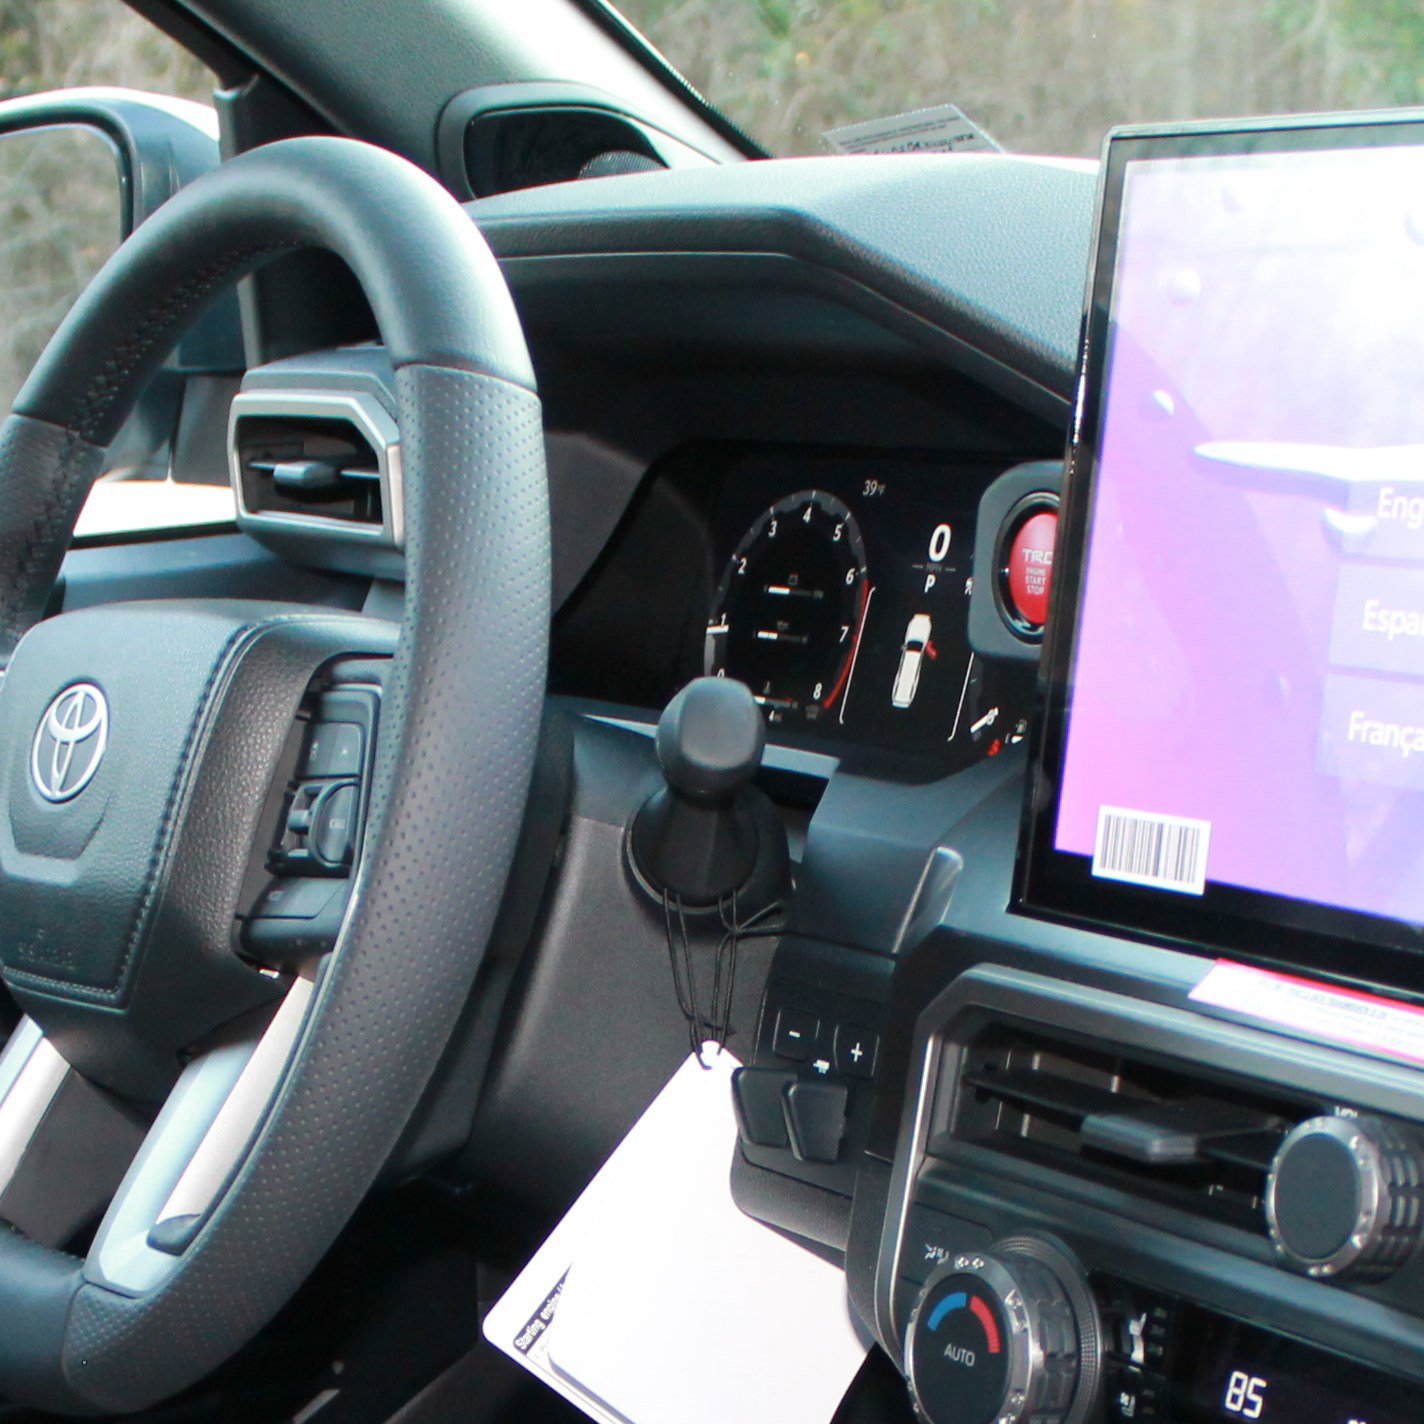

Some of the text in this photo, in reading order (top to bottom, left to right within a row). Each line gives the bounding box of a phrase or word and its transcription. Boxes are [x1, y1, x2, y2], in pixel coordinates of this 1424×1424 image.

[802, 506, 812, 523] 4
[768, 520, 778, 537] 3
[832, 524, 843, 541] 5
[928, 523, 952, 563] 0
[737, 557, 748, 575] 2
[845, 567, 855, 585] 6
[924, 573, 936, 593] P
[1025, 575, 1047, 586] START
[1026, 585, 1045, 596] STOP
[839, 626, 849, 643] 7
[813, 682, 823, 700] 8
[943, 1342, 976, 1368] AUTO
[1226, 1371, 1267, 1419] 85
